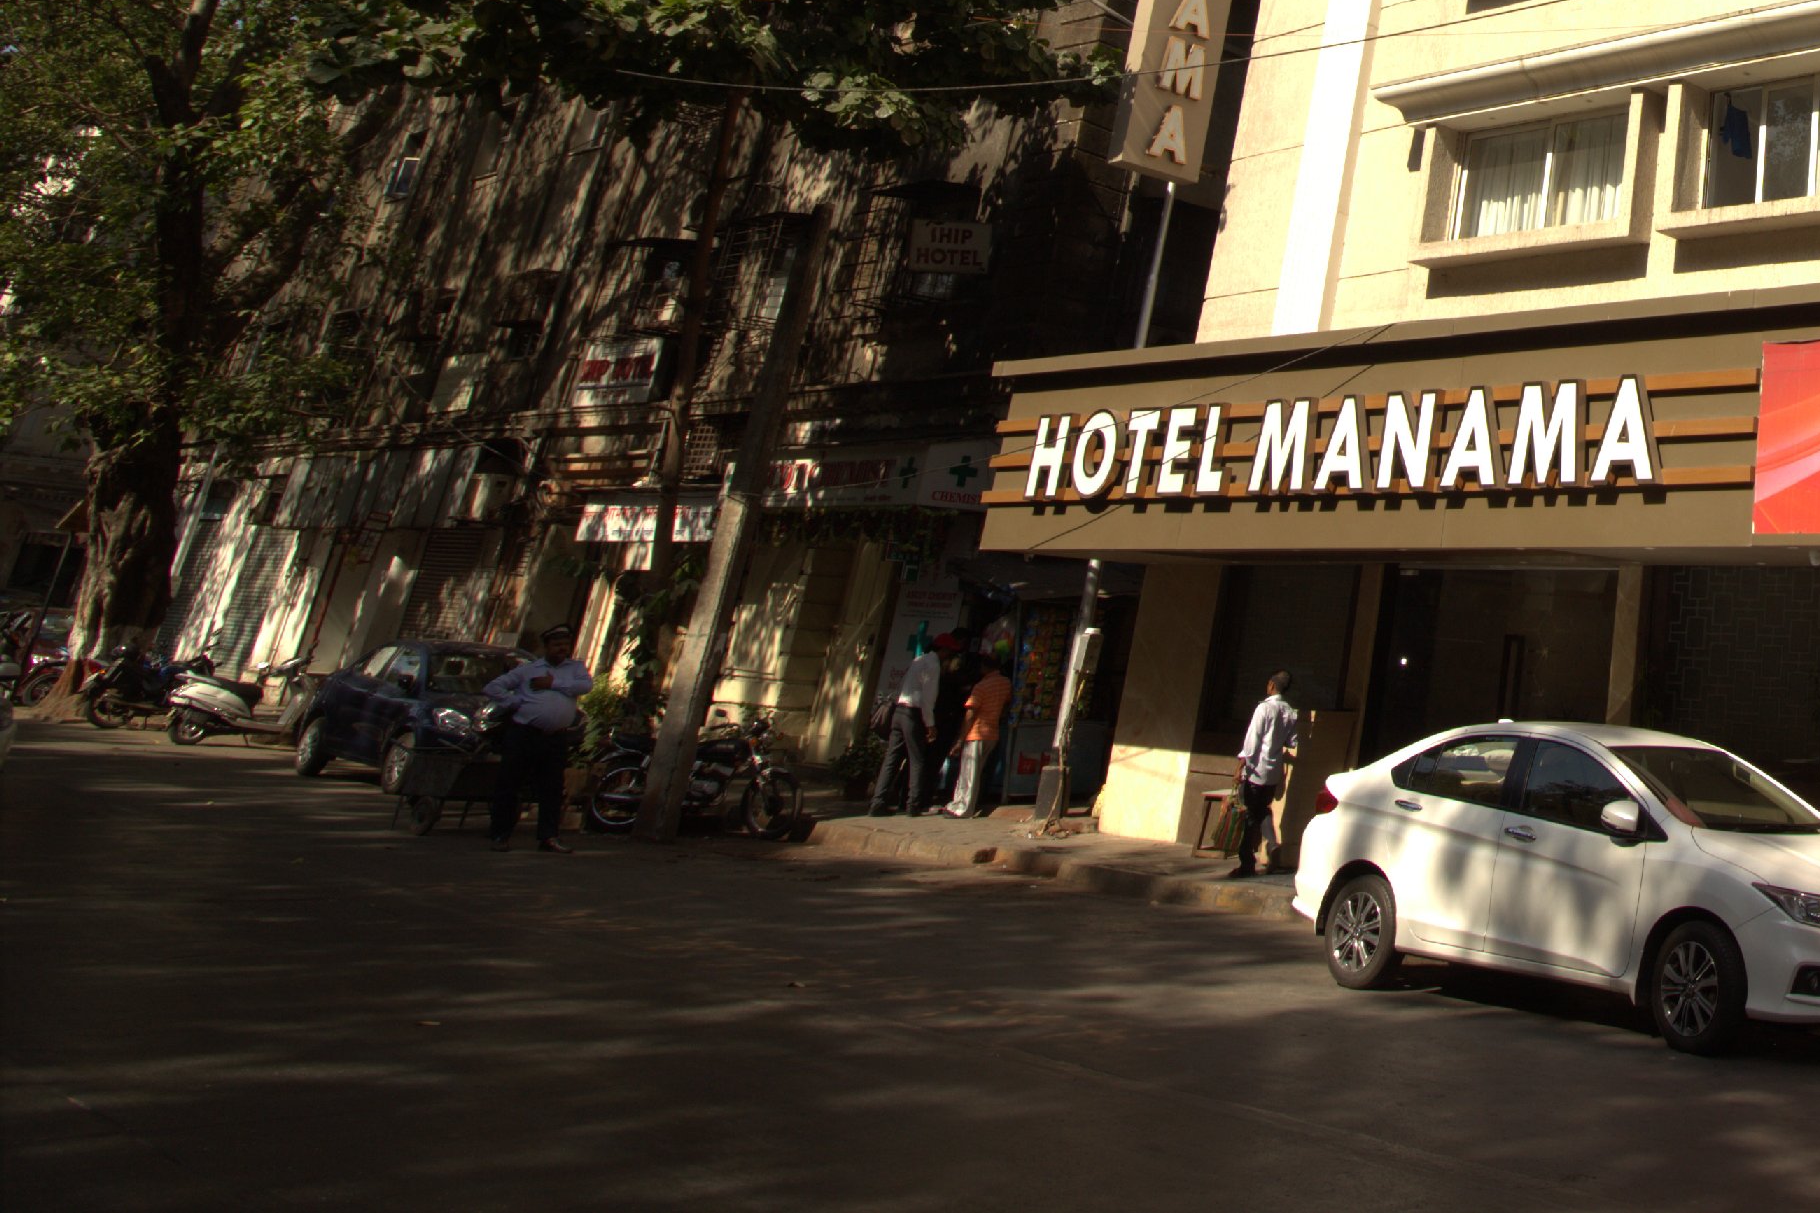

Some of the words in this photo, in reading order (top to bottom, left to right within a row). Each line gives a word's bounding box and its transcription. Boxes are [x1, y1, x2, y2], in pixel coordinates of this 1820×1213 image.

[916, 247, 984, 266] HOTEL
[1024, 402, 1232, 499] HOTEL
[1247, 374, 1656, 492] MANAMA
